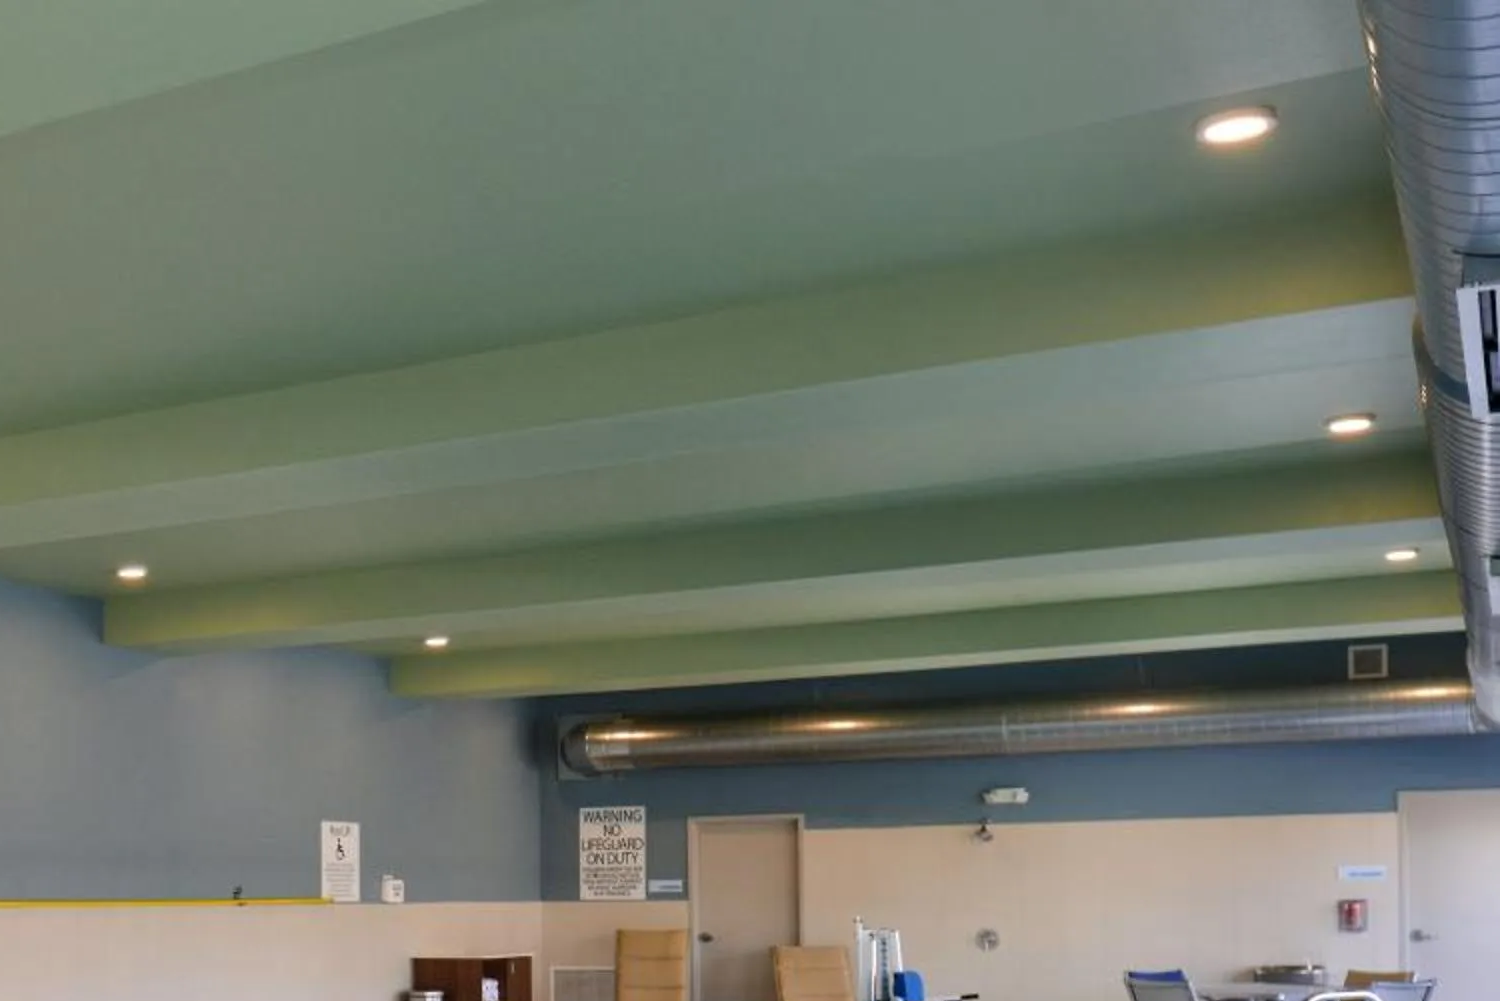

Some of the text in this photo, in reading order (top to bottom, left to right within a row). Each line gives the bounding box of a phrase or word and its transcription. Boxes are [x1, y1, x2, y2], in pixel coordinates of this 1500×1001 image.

[583, 809, 643, 823] WARNING
[603, 824, 622, 837] NO
[582, 837, 645, 851] LIFEGUARD
[586, 851, 638, 865] ON DUTY
